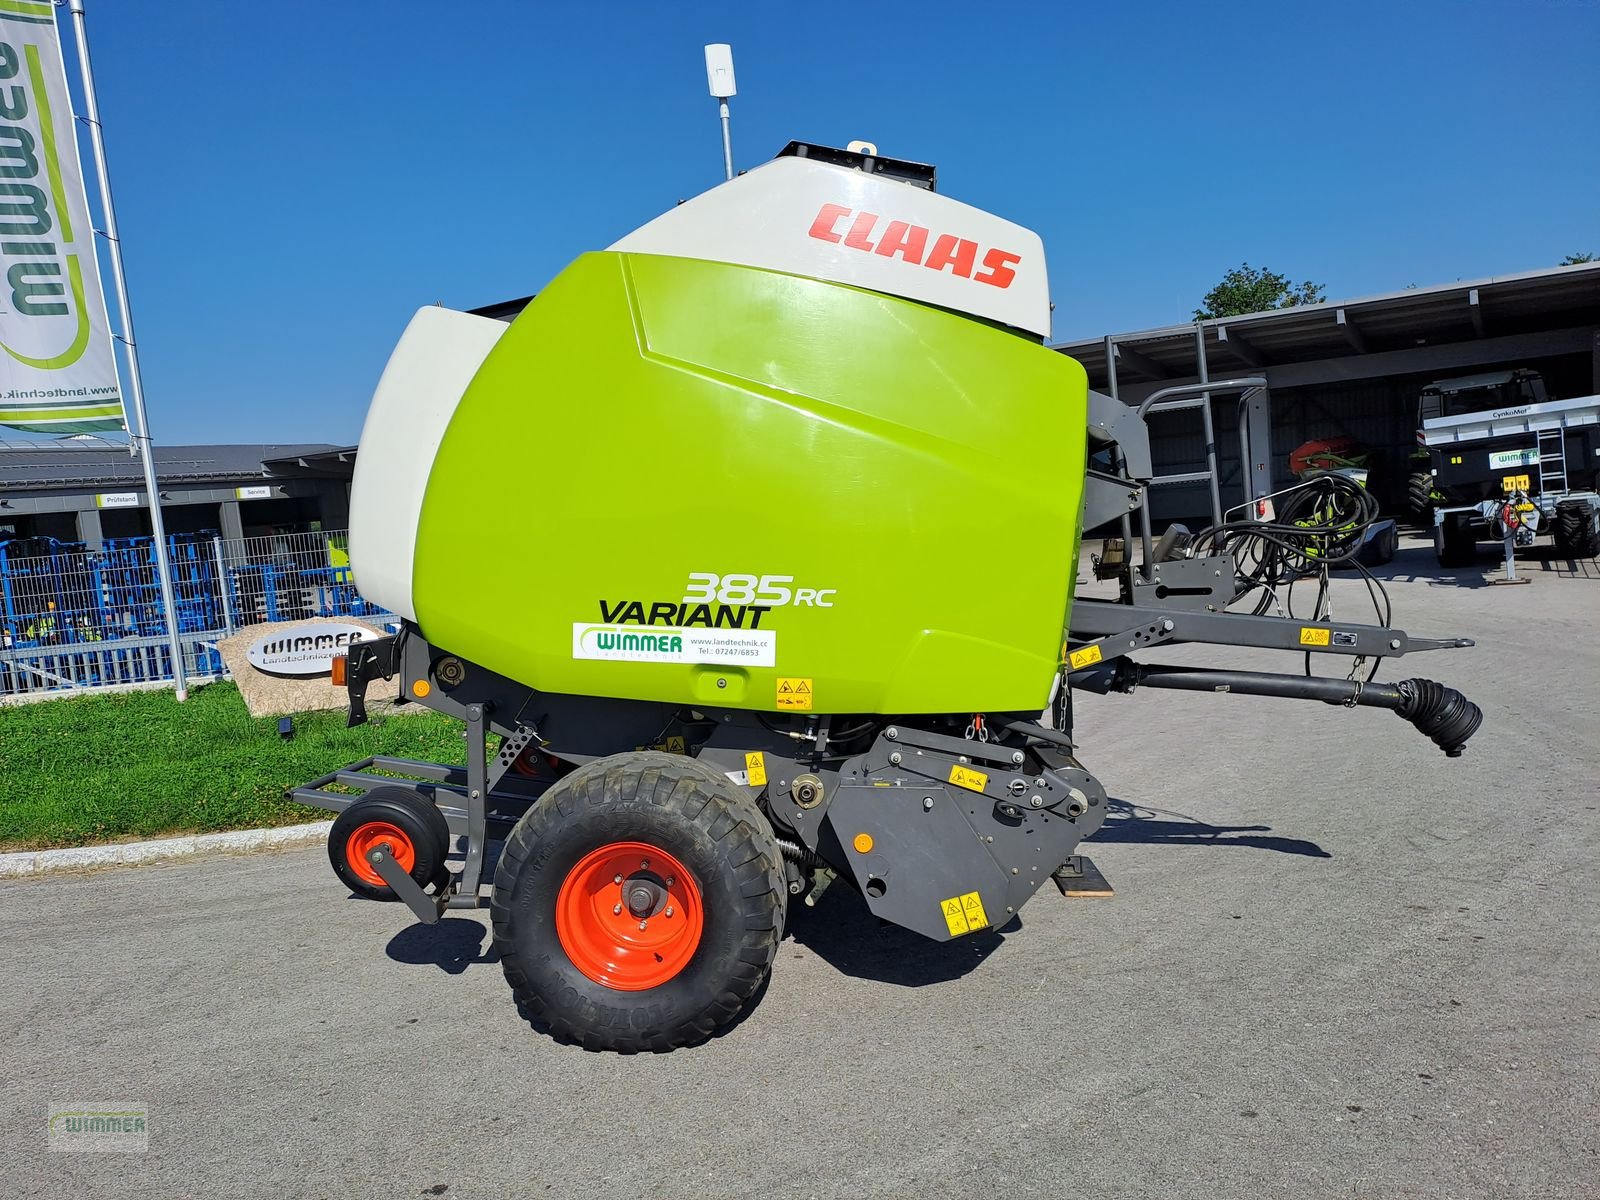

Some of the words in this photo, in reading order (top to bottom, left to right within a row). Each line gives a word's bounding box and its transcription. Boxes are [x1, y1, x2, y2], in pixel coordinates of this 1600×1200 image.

[808, 203, 1022, 289] CLAAS
[1498, 451, 1538, 462] WIMMER
[682, 572, 794, 607] 385
[793, 588, 837, 607] RC
[599, 600, 771, 629] VARIANT
[597, 632, 683, 653] WIMMER
[690, 638, 768, 648] www.landtechnik.cc
[715, 648, 760, 657] 07247/6853
